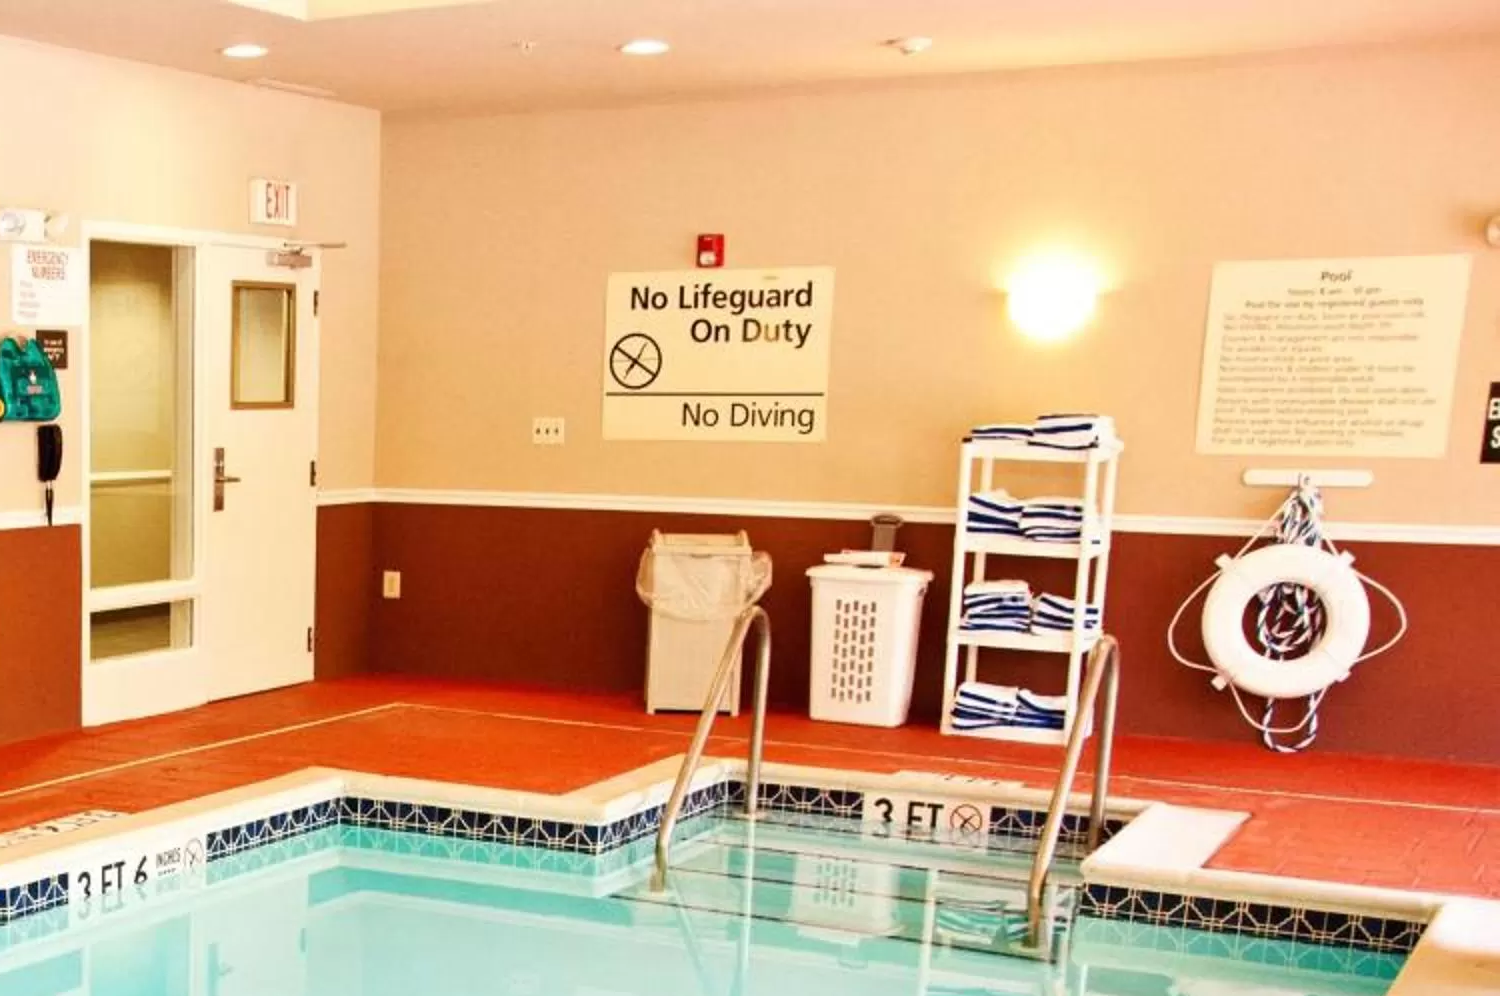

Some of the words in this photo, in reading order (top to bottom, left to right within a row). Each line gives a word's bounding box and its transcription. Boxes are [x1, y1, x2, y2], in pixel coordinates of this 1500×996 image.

[265, 181, 291, 220] EXIT
[1320, 269, 1353, 282] Pool
[631, 286, 668, 310] No
[679, 281, 813, 315] Lifeguard
[690, 318, 730, 343] On
[742, 317, 812, 349] Duty
[682, 402, 719, 427] No
[730, 401, 815, 434] Diving
[907, 801, 944, 828] FT
[101, 860, 125, 894] FT
[134, 855, 148, 885] 6
